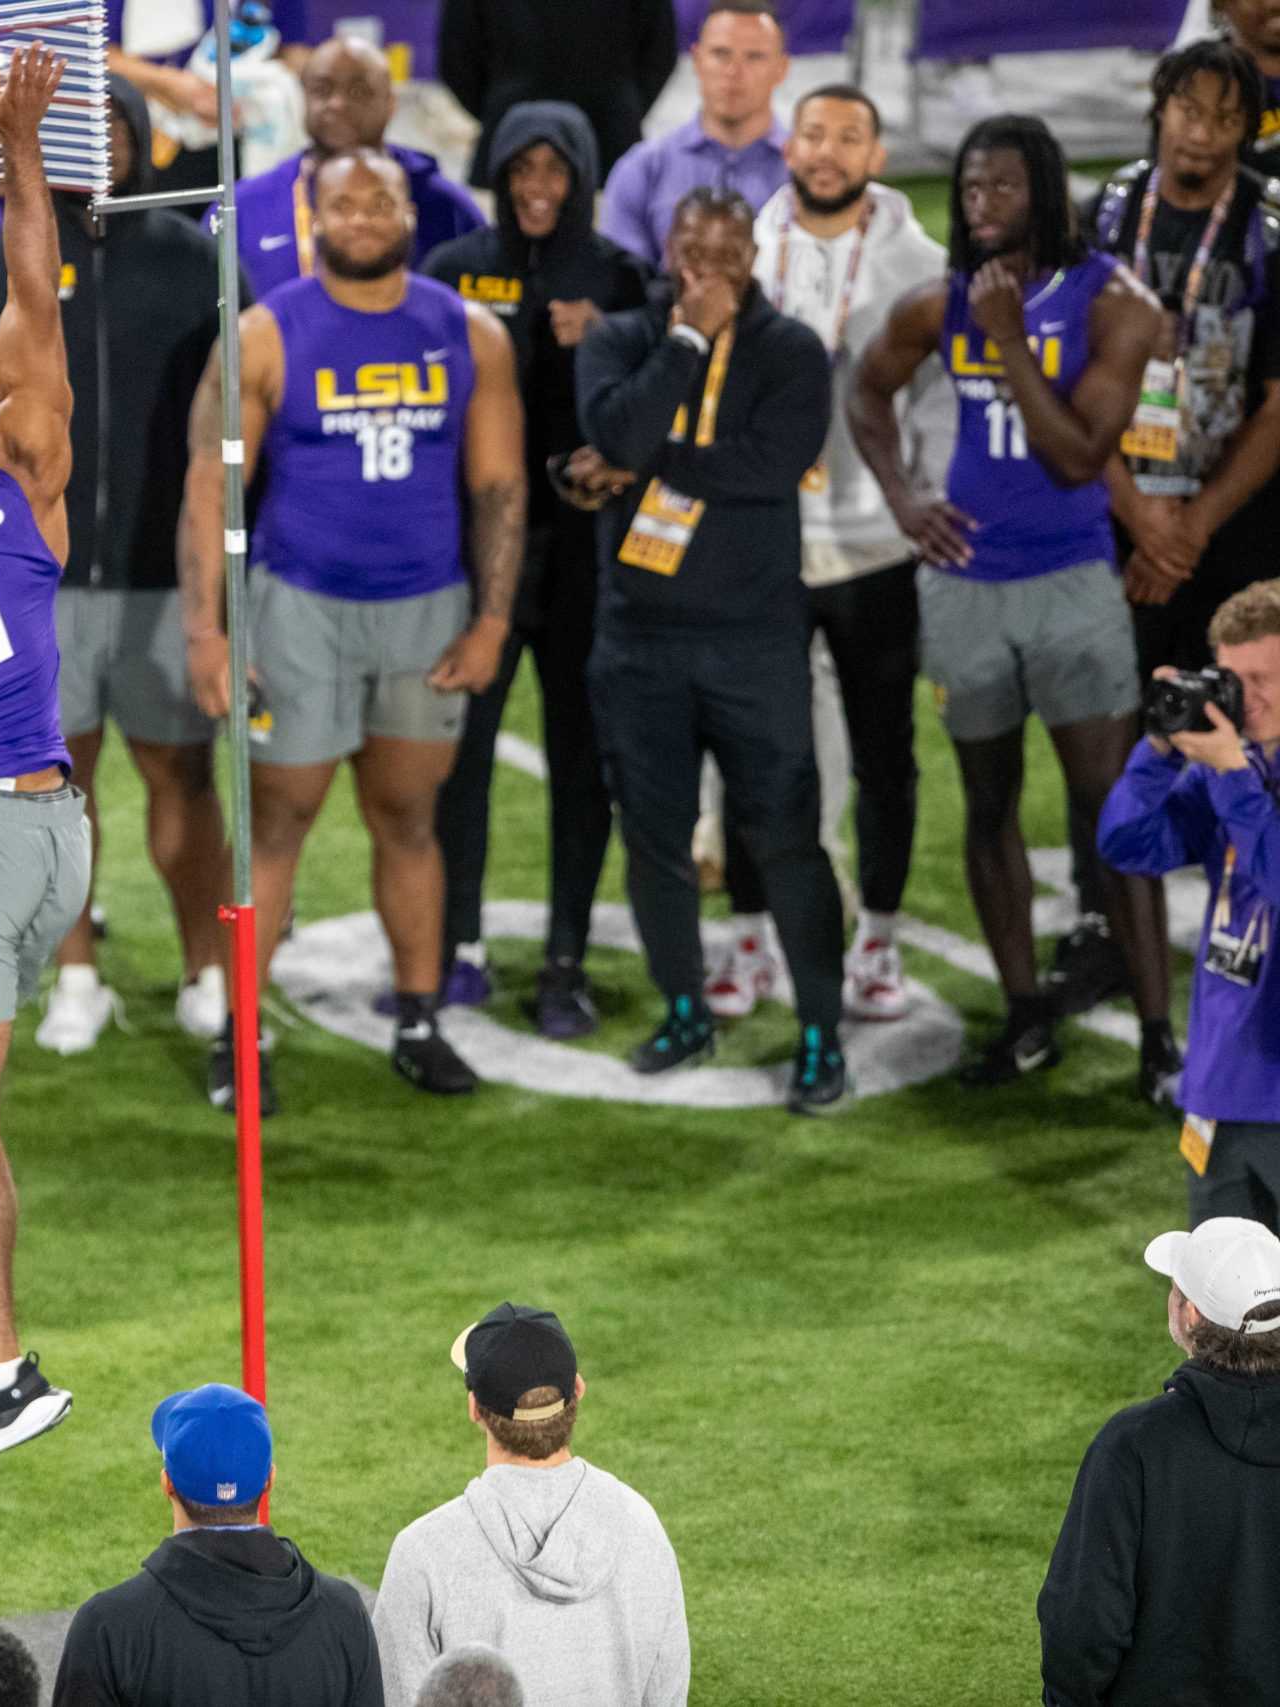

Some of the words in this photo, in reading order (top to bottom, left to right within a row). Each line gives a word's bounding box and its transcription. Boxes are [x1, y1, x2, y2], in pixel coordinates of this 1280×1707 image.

[315, 362, 448, 411] LSU
[322, 411, 369, 435] PRO
[395, 408, 447, 431] DAY
[356, 426, 414, 482] 18
